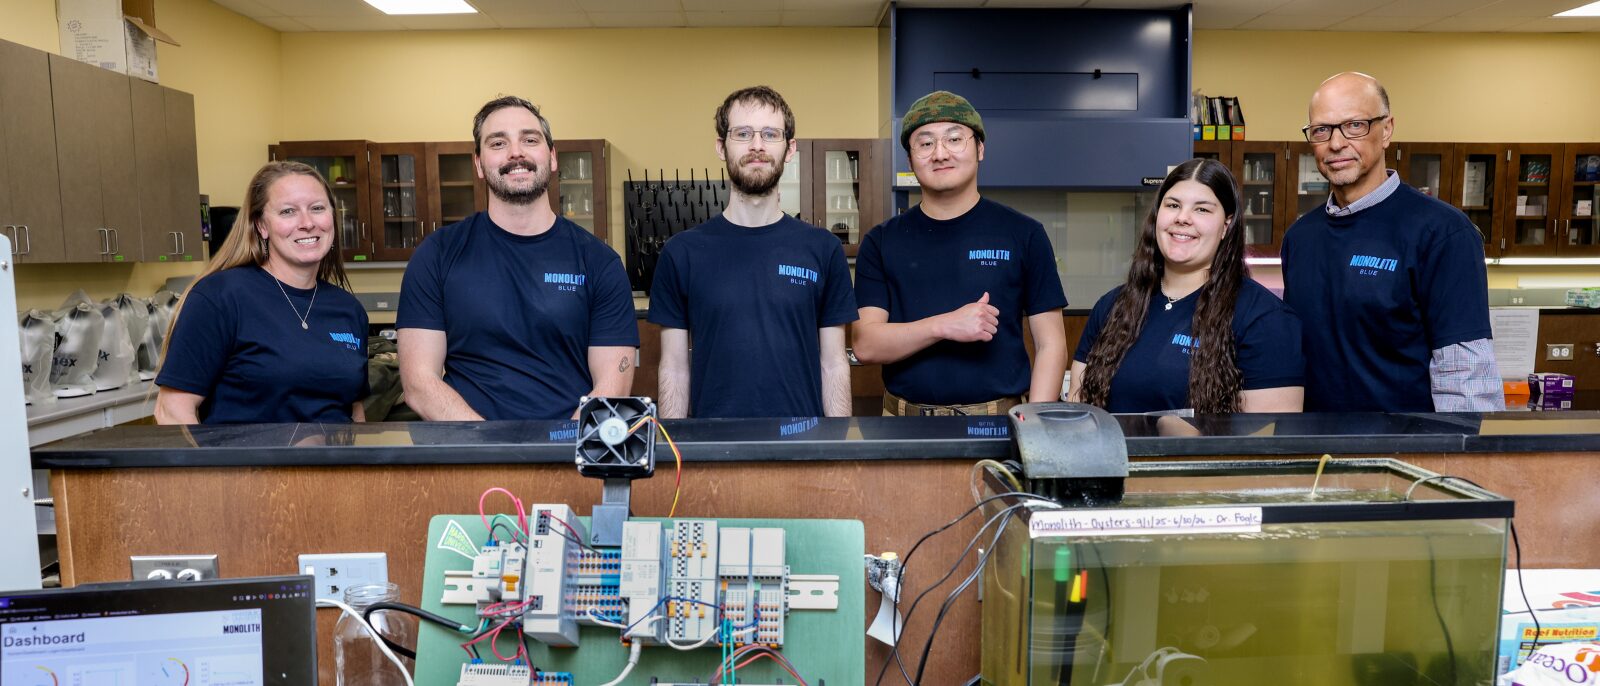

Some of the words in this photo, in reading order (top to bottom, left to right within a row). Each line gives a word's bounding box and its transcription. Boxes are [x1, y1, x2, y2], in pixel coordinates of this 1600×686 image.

[968, 249, 1010, 261] MONOLITH
[1349, 254, 1398, 272] MONOLITH
[778, 264, 818, 283] MONOLITH
[1359, 268, 1379, 276] BLUE
[790, 278, 807, 286] BLUE
[1031, 518, 1082, 531] Monolith
[1091, 516, 1130, 530] Oysters
[1136, 517, 1166, 529] 9/1/25
[223, 623, 261, 634] MONOLITH
[1525, 629, 1550, 637] Reef
[1552, 628, 1595, 637] Nutrition
[3, 632, 86, 648] Dashboard
